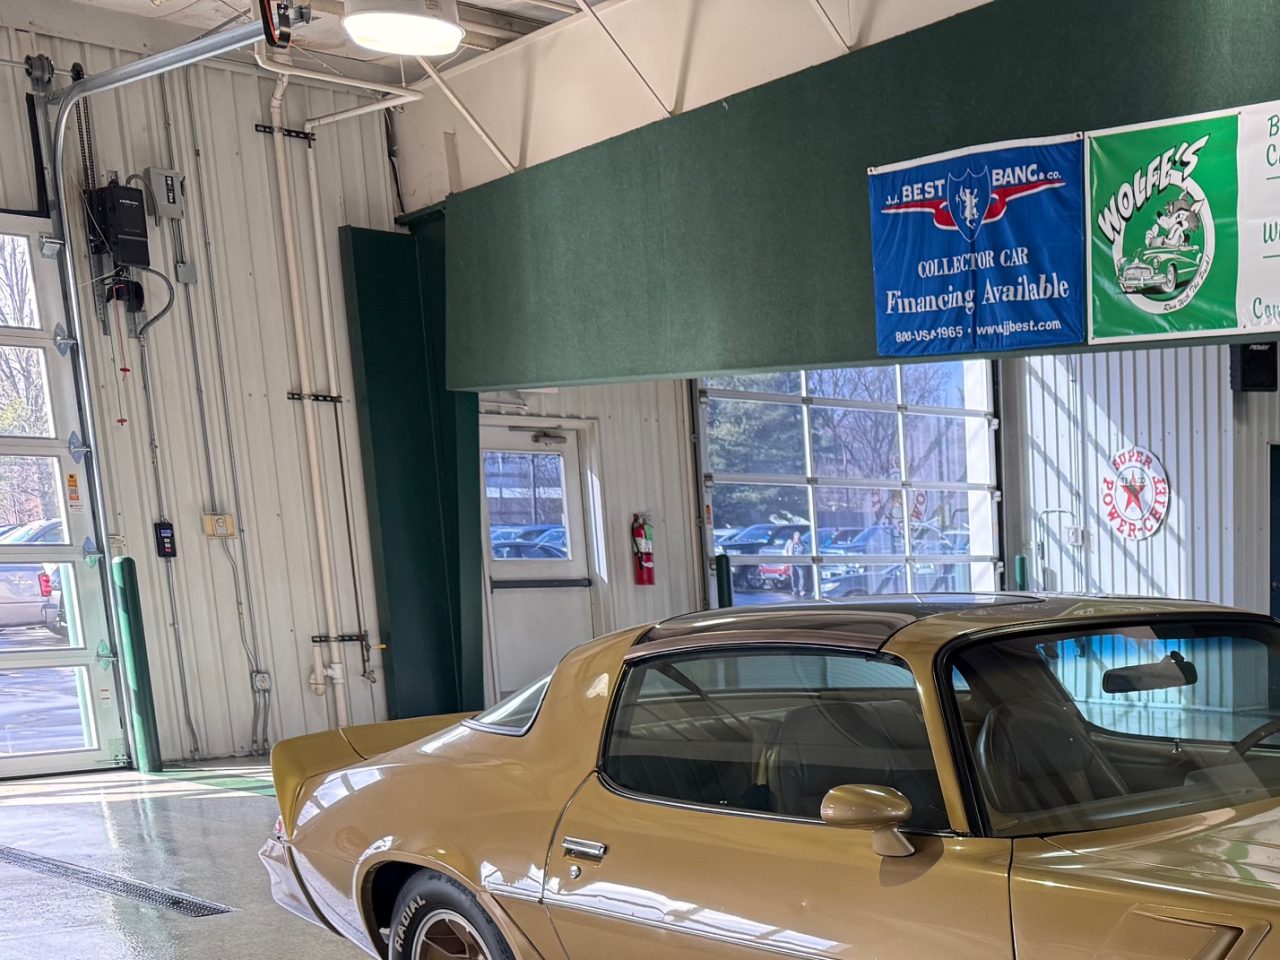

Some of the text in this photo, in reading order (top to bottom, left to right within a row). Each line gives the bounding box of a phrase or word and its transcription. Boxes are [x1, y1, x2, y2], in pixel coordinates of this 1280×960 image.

[902, 179, 945, 202] BEST
[1098, 134, 1210, 243] WOLFE'S
[918, 247, 1029, 278] COLLECTOR CAR
[886, 272, 1070, 315] Financing Available
[1112, 448, 1153, 471] SUPER
[394, 896, 426, 953] RADIAL
